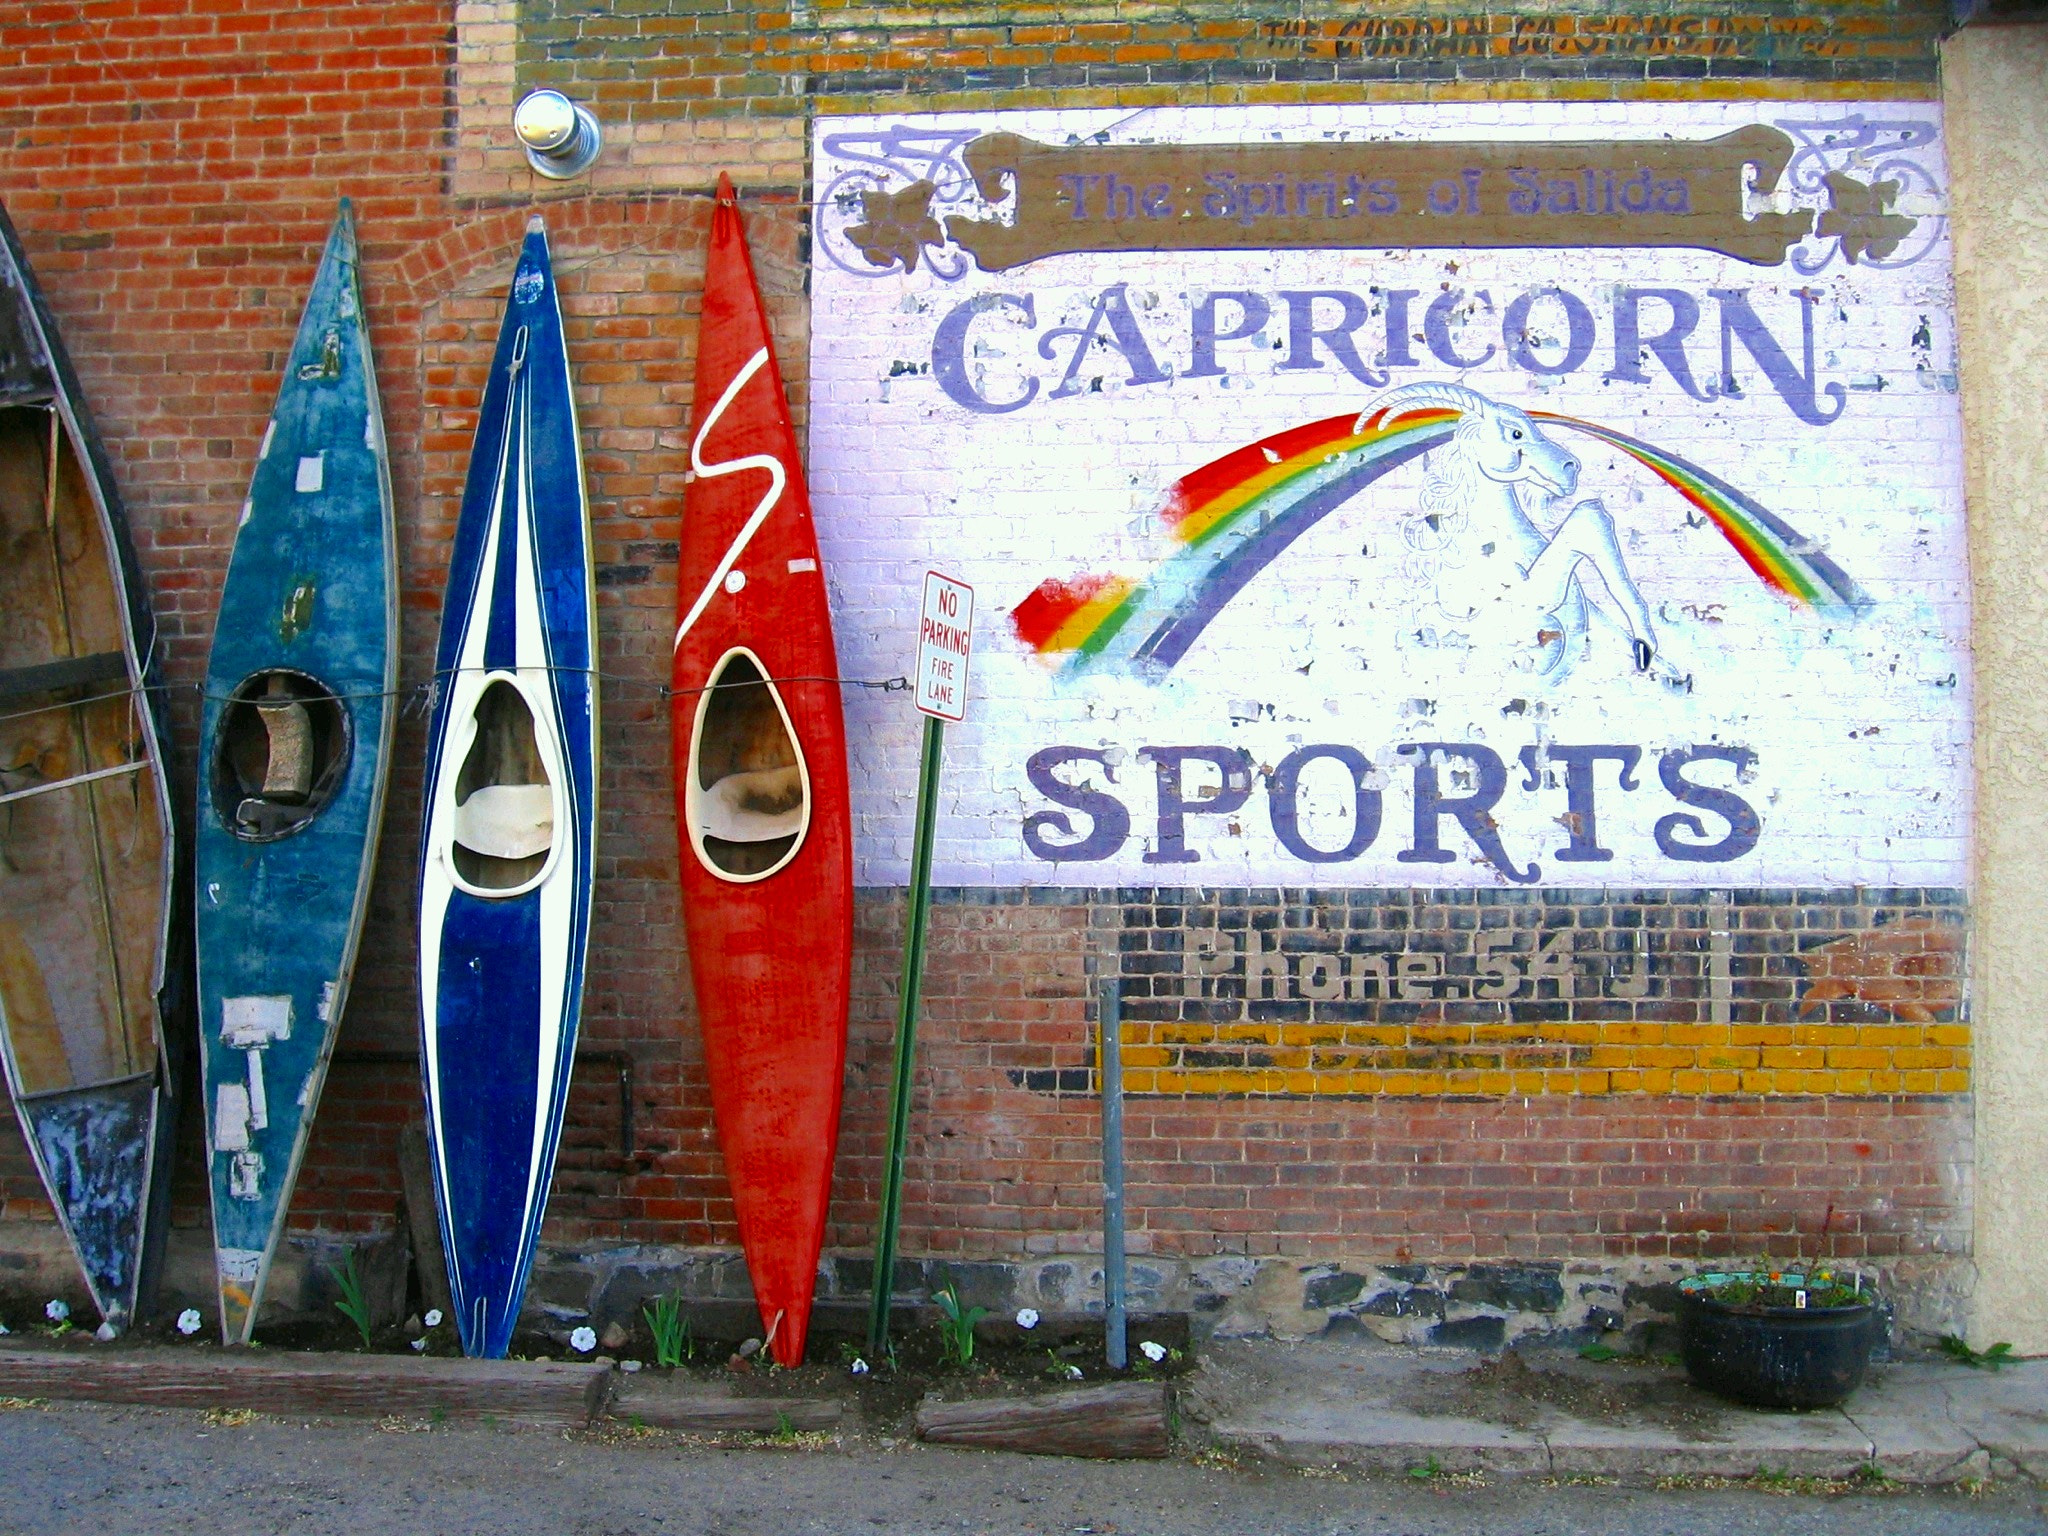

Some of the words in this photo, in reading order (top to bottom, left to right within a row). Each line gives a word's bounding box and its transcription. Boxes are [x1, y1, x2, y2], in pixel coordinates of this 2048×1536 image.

[1262, 21, 1318, 54] THE
[1065, 172, 1175, 219] The
[1203, 171, 1399, 227] Spirits
[1427, 169, 1483, 214] of
[1507, 167, 1692, 216] Salida
[931, 281, 1848, 427] CAPRICORN
[938, 589, 957, 617] NO
[922, 617, 969, 656] PARKING
[931, 657, 954, 680] FIRE
[927, 681, 954, 704] LANE
[1021, 742, 1762, 885] SPORTS
